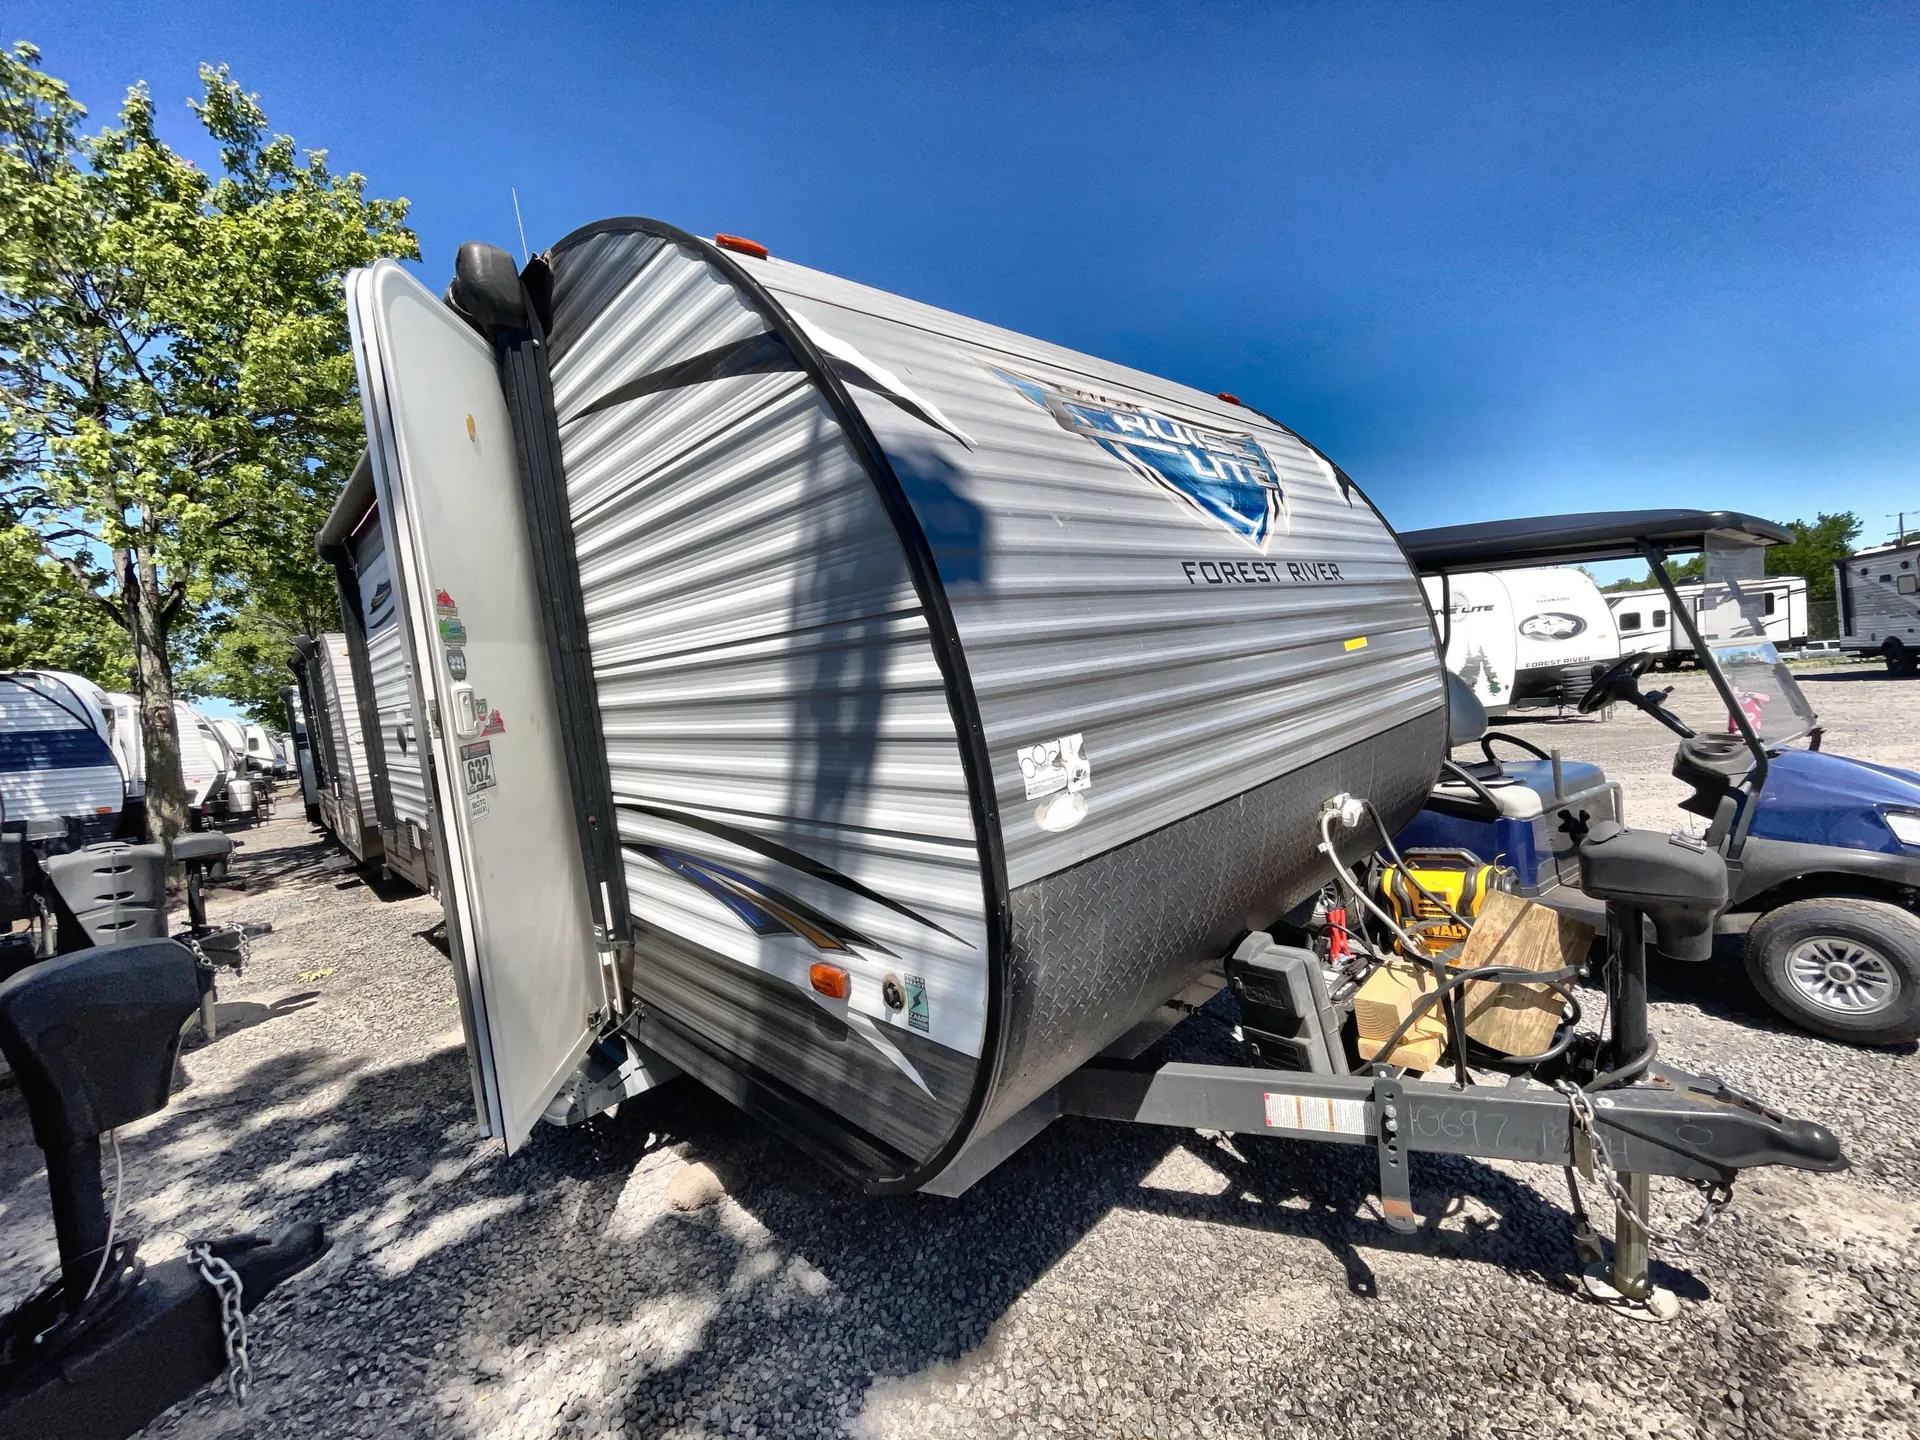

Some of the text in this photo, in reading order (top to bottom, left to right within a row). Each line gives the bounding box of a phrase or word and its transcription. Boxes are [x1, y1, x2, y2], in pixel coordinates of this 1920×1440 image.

[1181, 449, 1279, 490] LITE
[1181, 561, 1345, 585] FOREST RIVER
[1461, 604, 1494, 614] LITE
[1525, 656, 1591, 669] FOREST RIVER
[467, 757, 491, 785] 632
[909, 1011, 929, 1024] ZAMP
